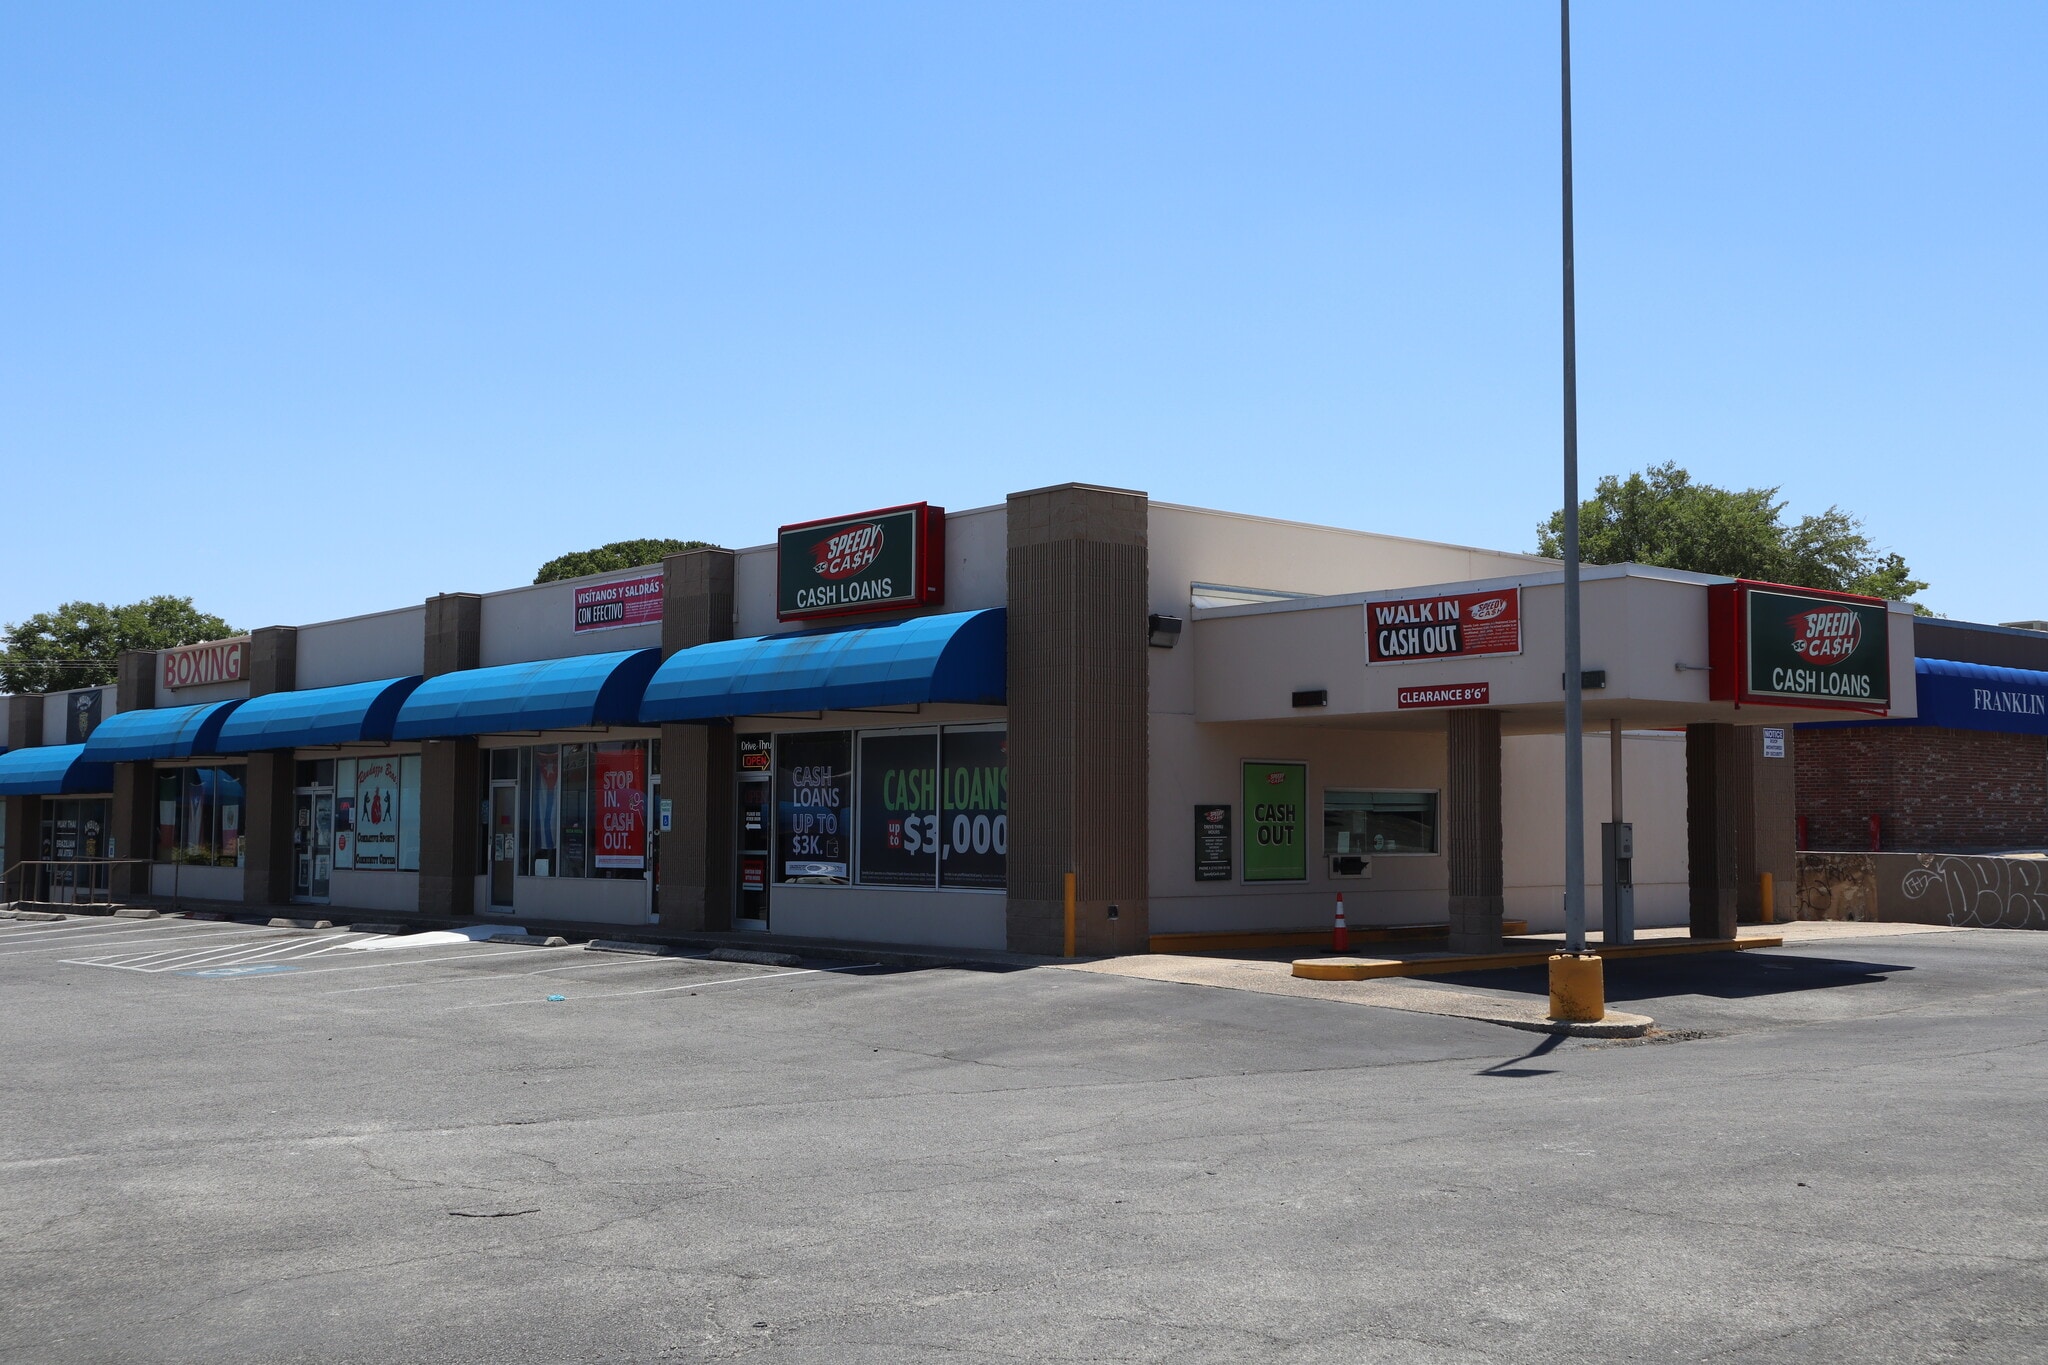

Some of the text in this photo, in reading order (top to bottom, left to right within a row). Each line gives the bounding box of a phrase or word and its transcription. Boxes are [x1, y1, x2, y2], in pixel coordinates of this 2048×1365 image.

[827, 524, 882, 560] SPEEDY
[578, 589, 617, 604] VISÍTANOS
[618, 587, 624, 598] Y
[625, 580, 660, 597] SALDRÁS
[797, 577, 892, 608] CASH LOANS
[578, 607, 592, 624] CON
[593, 603, 623, 622] EFECTIVO
[1375, 600, 1460, 625] WALK IN
[1804, 612, 1858, 638] SPEEDY
[1379, 628, 1420, 657] CASH
[1422, 625, 1457, 653] OUT
[164, 644, 240, 688] BOXING
[1772, 667, 1871, 697] CASH LOANS
[1400, 689, 1463, 703] CLEARANCE
[1973, 688, 2045, 715] FRANKLIN
[1764, 730, 1783, 739] NOTICE
[745, 756, 767, 766] OPEN
[603, 770, 634, 790] STOP
[793, 765, 832, 787] CASH
[604, 791, 620, 808] IN.
[793, 787, 840, 808] LOANS
[883, 768, 936, 811] CASH
[603, 813, 635, 832] CASH
[793, 813, 838, 834] UP TO
[1254, 803, 1296, 823] CASH
[889, 823, 900, 836] up
[903, 813, 1008, 861] $3,000
[1257, 825, 1295, 846] OUT
[603, 832, 632, 850] OUT.
[793, 834, 823, 855] $3K.
[889, 836, 900, 846] to
